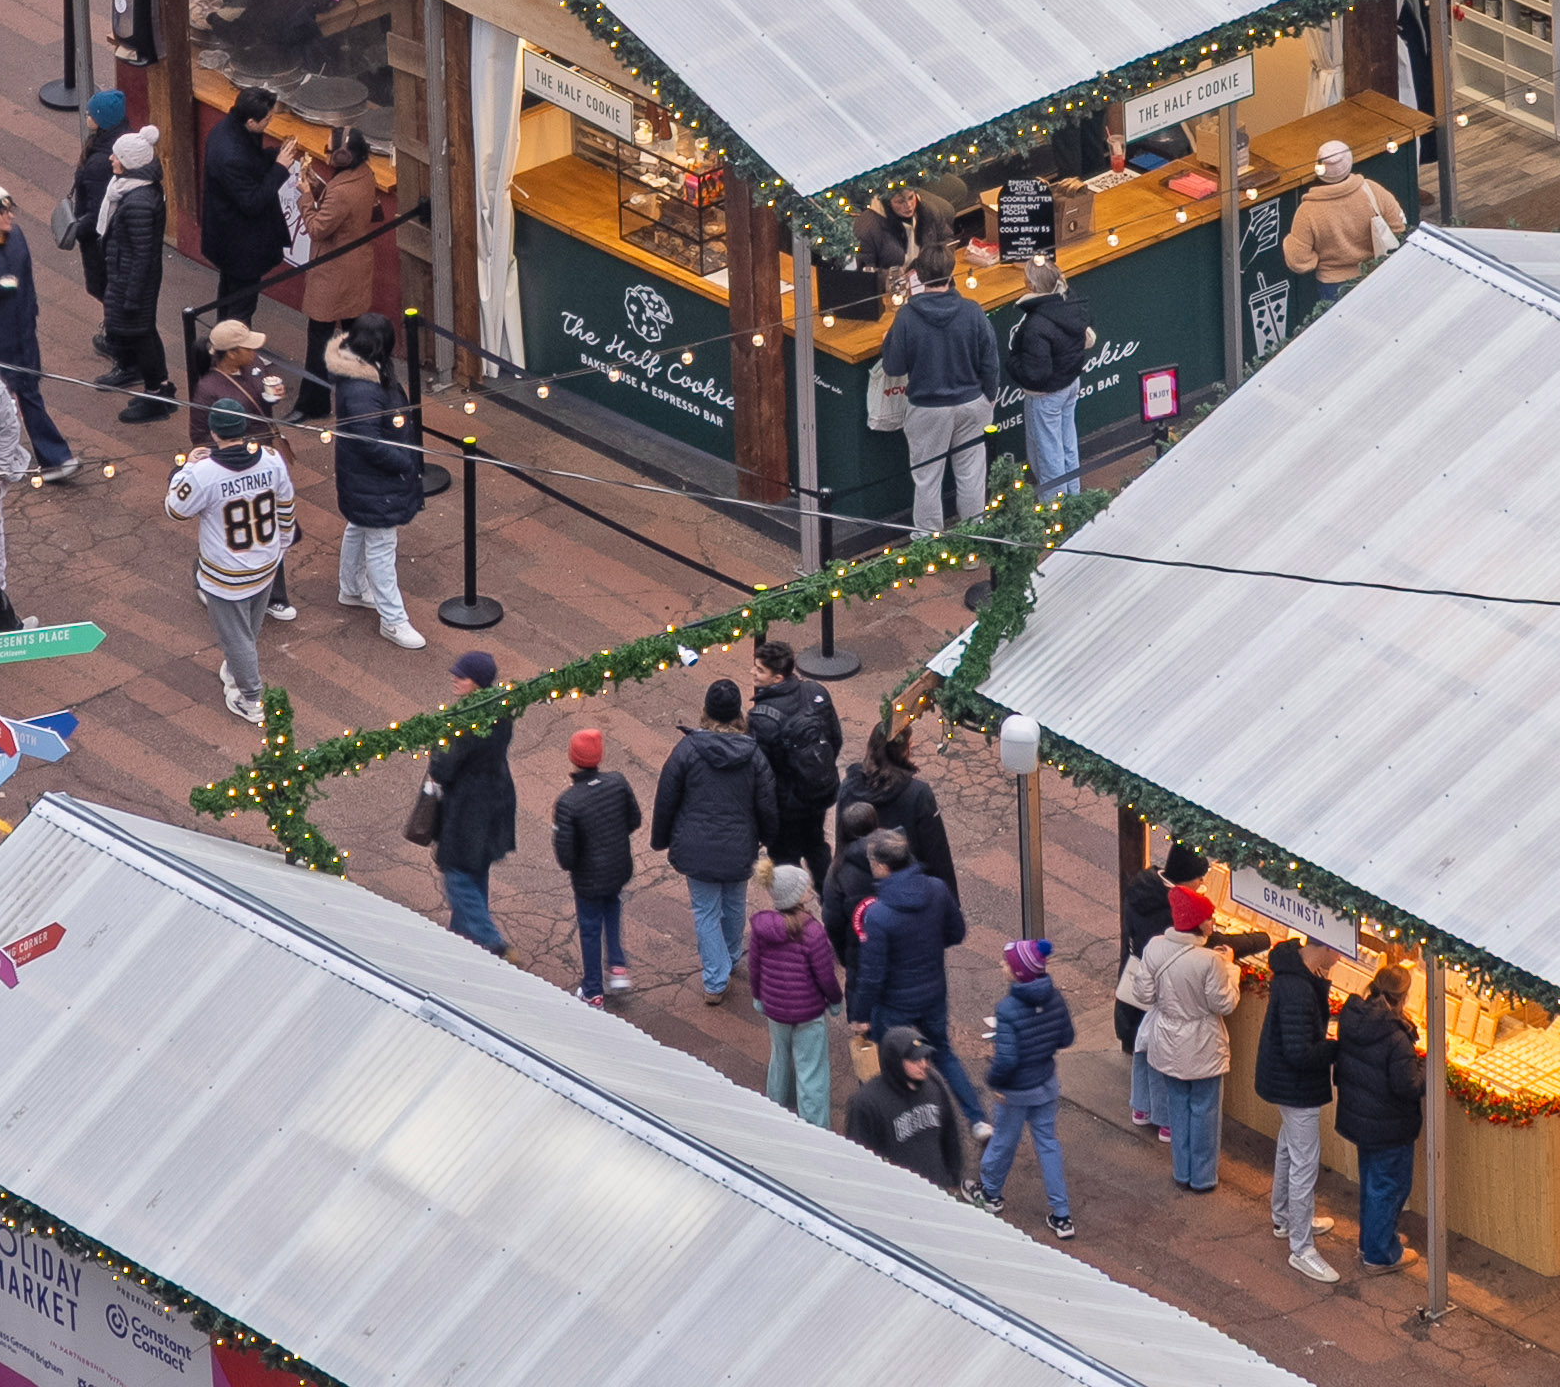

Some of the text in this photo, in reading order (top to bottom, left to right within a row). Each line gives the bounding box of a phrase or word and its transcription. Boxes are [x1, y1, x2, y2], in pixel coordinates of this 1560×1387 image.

[534, 67, 623, 126] THE HALF COOKIE
[1138, 72, 1241, 125] THE HALF COOKIE
[561, 309, 736, 411] The Half Cookie
[1148, 387, 1171, 402] ENJOY
[222, 488, 277, 554] 88
[38, 629, 71, 645] PLACE
[1263, 886, 1326, 930] GRATINSTA
[131, 1316, 192, 1362] Constant
[131, 1333, 185, 1374] Contact
